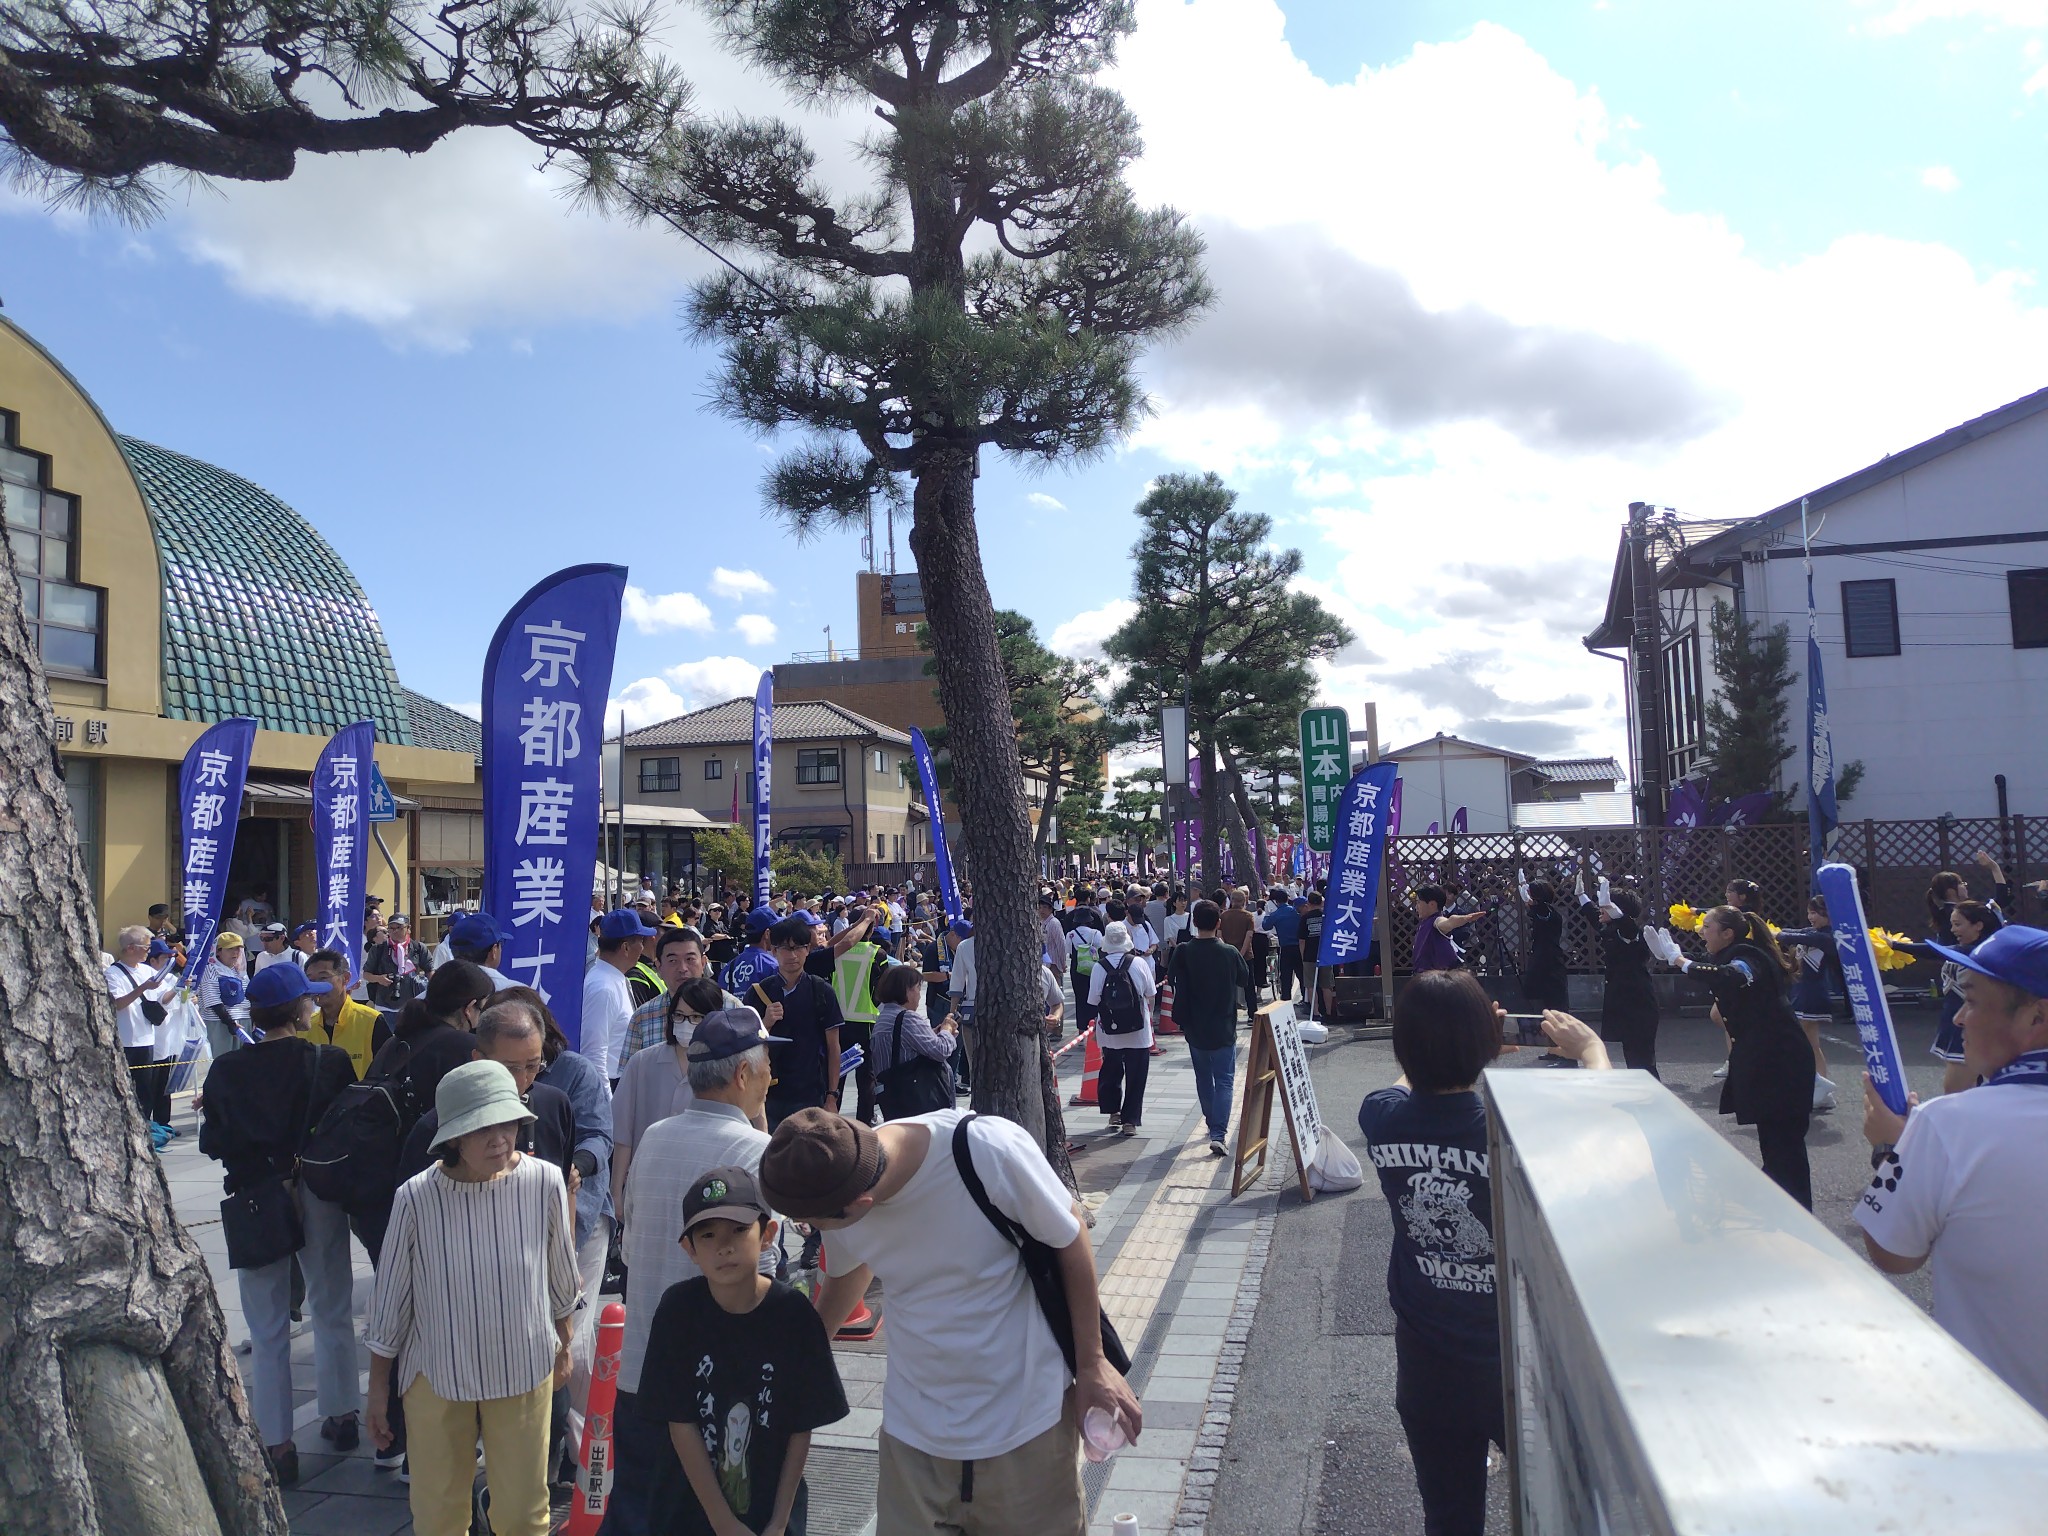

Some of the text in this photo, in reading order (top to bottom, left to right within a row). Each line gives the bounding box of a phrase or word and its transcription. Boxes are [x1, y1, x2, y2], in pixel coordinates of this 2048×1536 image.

[54, 716, 108, 744] 前駅
[1310, 715, 1342, 782] 山本
[1311, 785, 1331, 844] 胃腸科
[324, 754, 359, 968] 京都産業大
[1331, 781, 1382, 958] 京都産業大学
[1842, 963, 1890, 1085] 京都産業大学
[1407, 1171, 1474, 1200] Bank
[1475, 1281, 1493, 1294] FC
[757, 1362, 775, 1429] これは
[588, 1445, 605, 1510] 出雲駅伝
